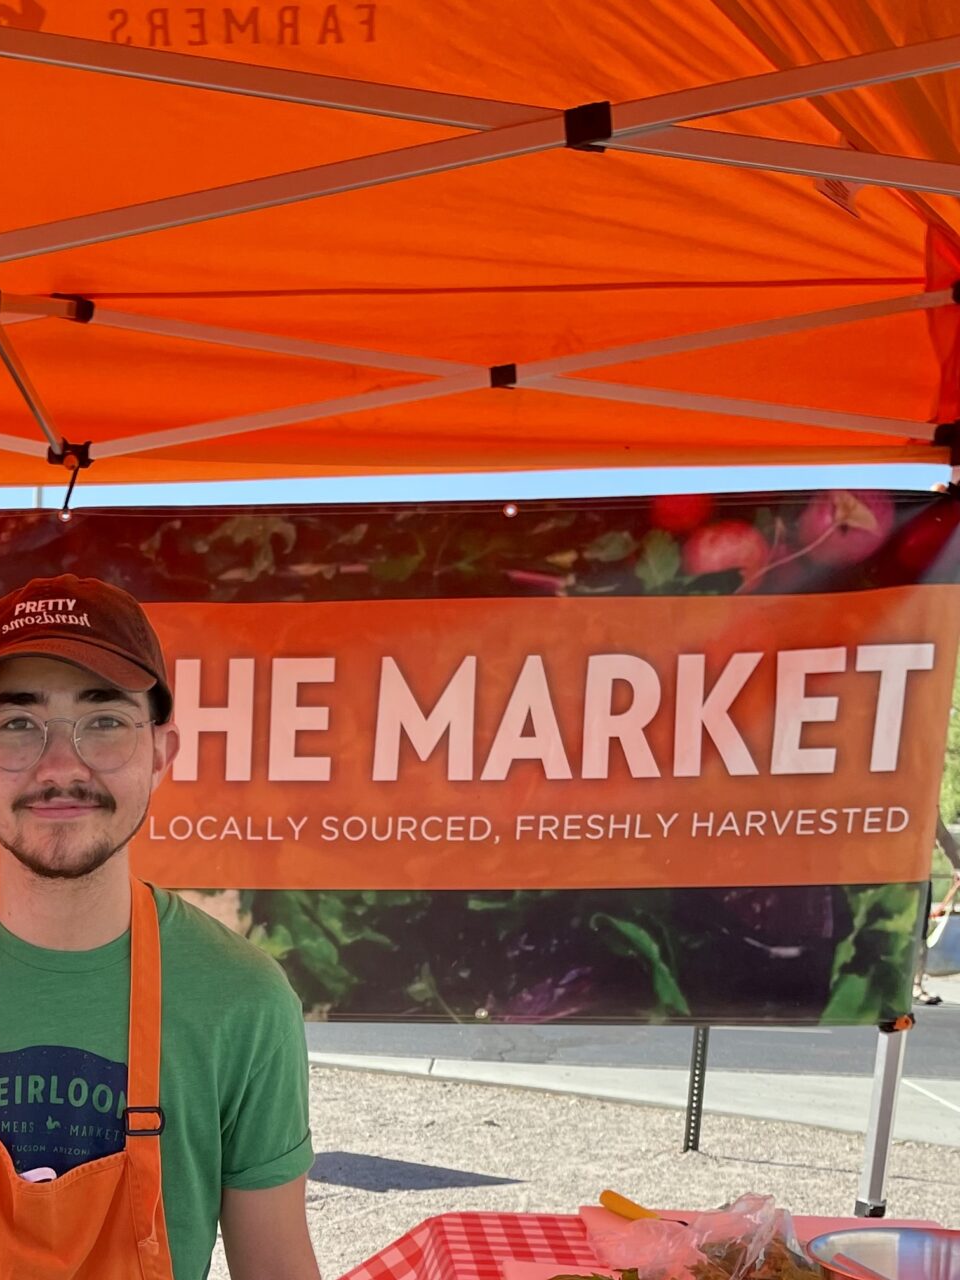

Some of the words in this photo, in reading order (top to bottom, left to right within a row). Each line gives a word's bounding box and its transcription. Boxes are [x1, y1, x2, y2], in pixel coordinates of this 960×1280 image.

[14, 598, 77, 616] PRETTY
[172, 657, 336, 781] HE
[372, 643, 936, 781] MARKET
[149, 815, 308, 841] LOCALLY
[320, 815, 500, 844] SOURCED,
[515, 813, 679, 840] FRESHLY
[691, 806, 910, 838] HARVESTED
